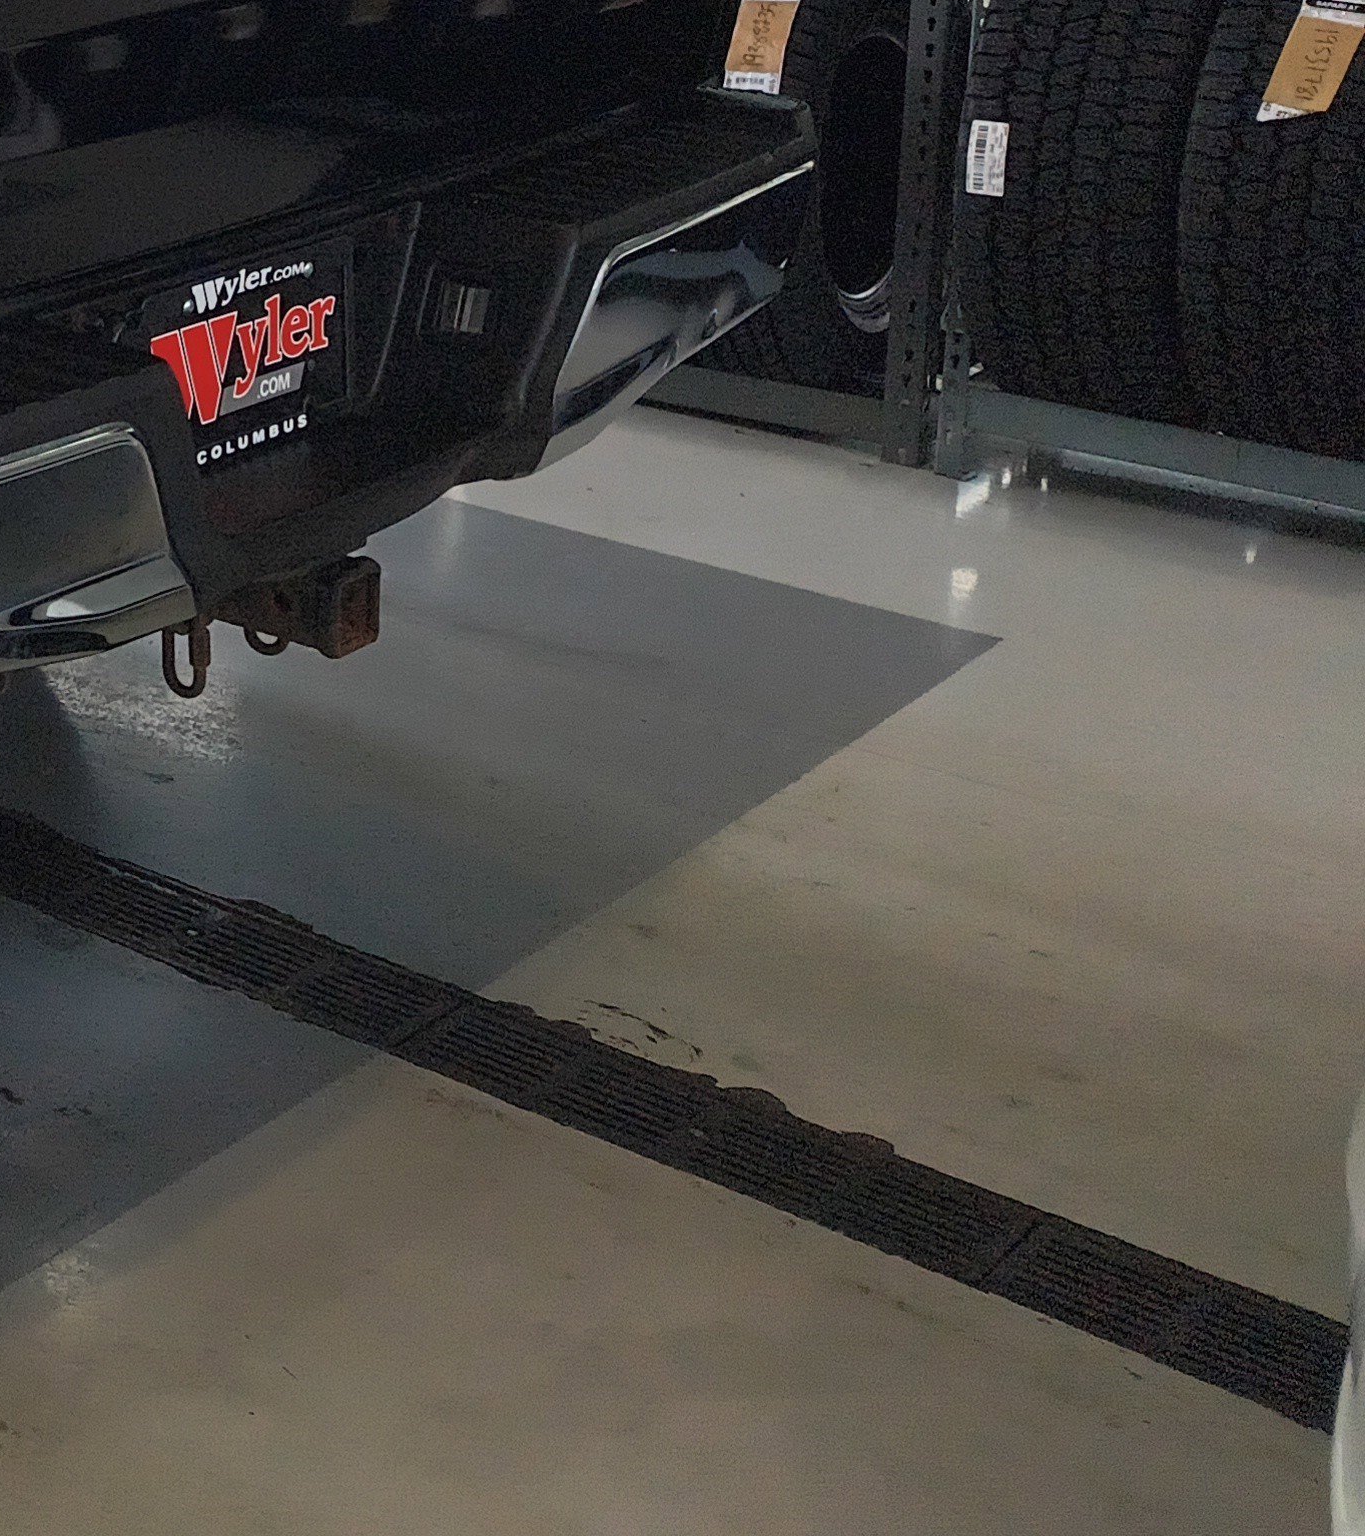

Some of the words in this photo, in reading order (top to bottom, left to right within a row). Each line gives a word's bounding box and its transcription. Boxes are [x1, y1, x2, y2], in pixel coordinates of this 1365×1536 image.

[149, 292, 337, 426] Wyler
[256, 372, 291, 399] .COM
[196, 412, 309, 466] COLUMBUS
